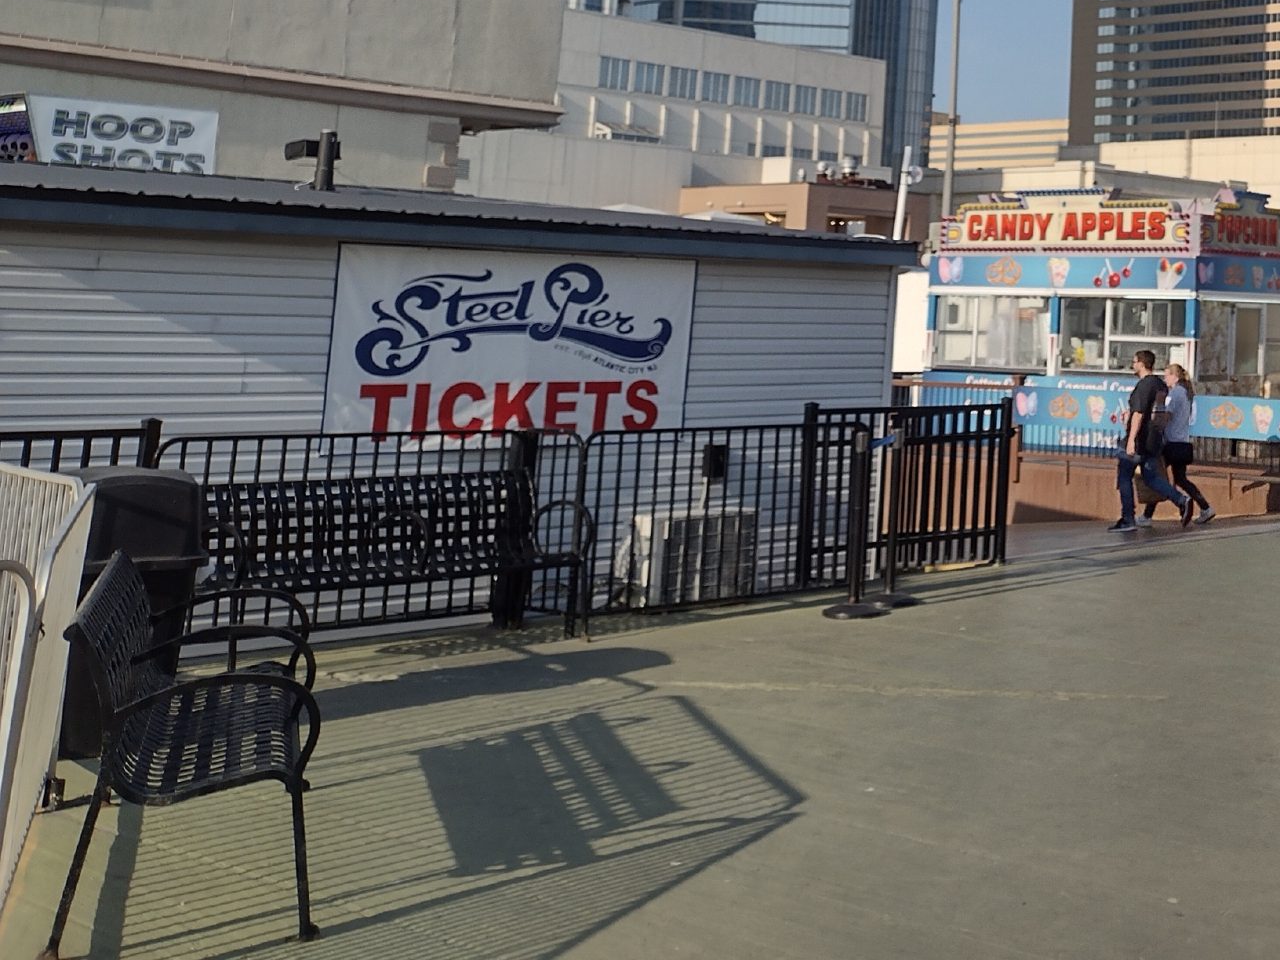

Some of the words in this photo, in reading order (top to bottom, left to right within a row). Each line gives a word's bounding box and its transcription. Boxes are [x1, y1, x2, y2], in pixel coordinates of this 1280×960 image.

[52, 109, 195, 146] HOOP
[967, 212, 1054, 241] CANDY
[1061, 211, 1168, 241] APPLES
[355, 269, 535, 377] Steel
[529, 262, 636, 342] Pier
[359, 379, 659, 443] TICKETS
